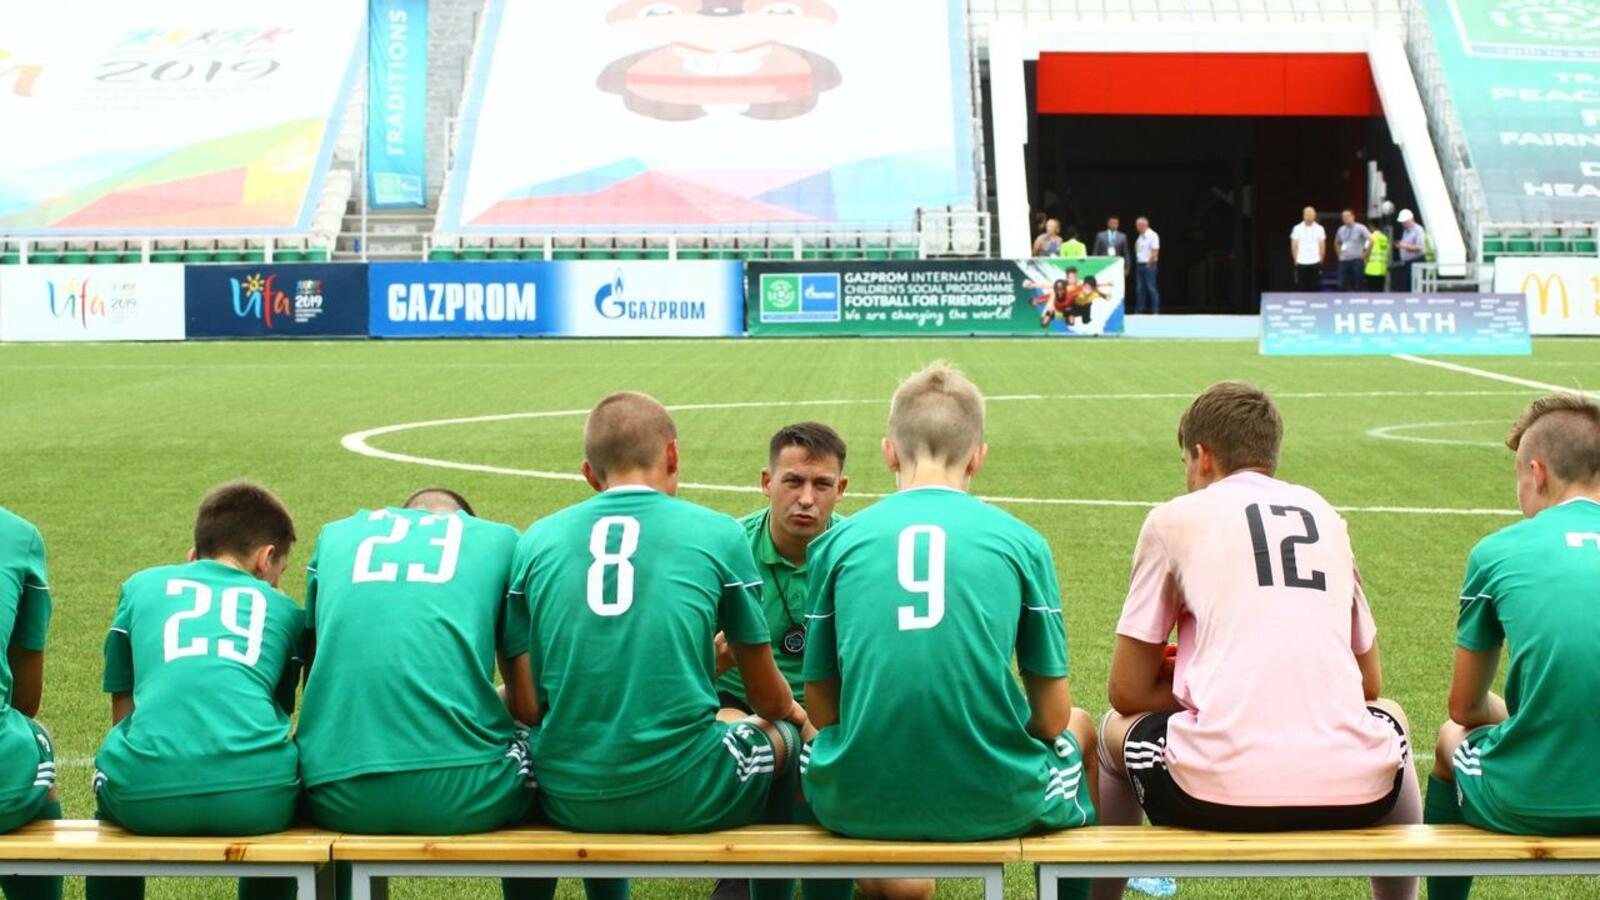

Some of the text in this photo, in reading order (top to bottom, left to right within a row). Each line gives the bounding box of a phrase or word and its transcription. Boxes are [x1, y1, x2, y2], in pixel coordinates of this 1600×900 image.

[93, 59, 281, 83] 2019
[386, 9, 408, 156] TRADITIONS
[844, 271, 1013, 283] GAZPROM INTERNATIONAL
[845, 283, 905, 294] CHILDREN'S
[907, 282, 945, 293] SOCIAL
[946, 282, 1014, 293] PROGRAMME
[110, 297, 138, 309] 2019
[294, 294, 323, 310] 2019
[387, 282, 537, 322] GAZPROM
[845, 294, 1015, 307] FOOTBALL FOR FRIENDSHIP
[845, 310, 860, 320] We
[865, 311, 886, 320] are
[891, 309, 944, 327] changing
[949, 308, 967, 320] the
[1334, 313, 1455, 334] HEALTH
[352, 509, 463, 584] 23
[1244, 502, 1327, 592] 12
[586, 515, 641, 617] 8
[897, 524, 945, 630] 9
[163, 579, 267, 667] 29
